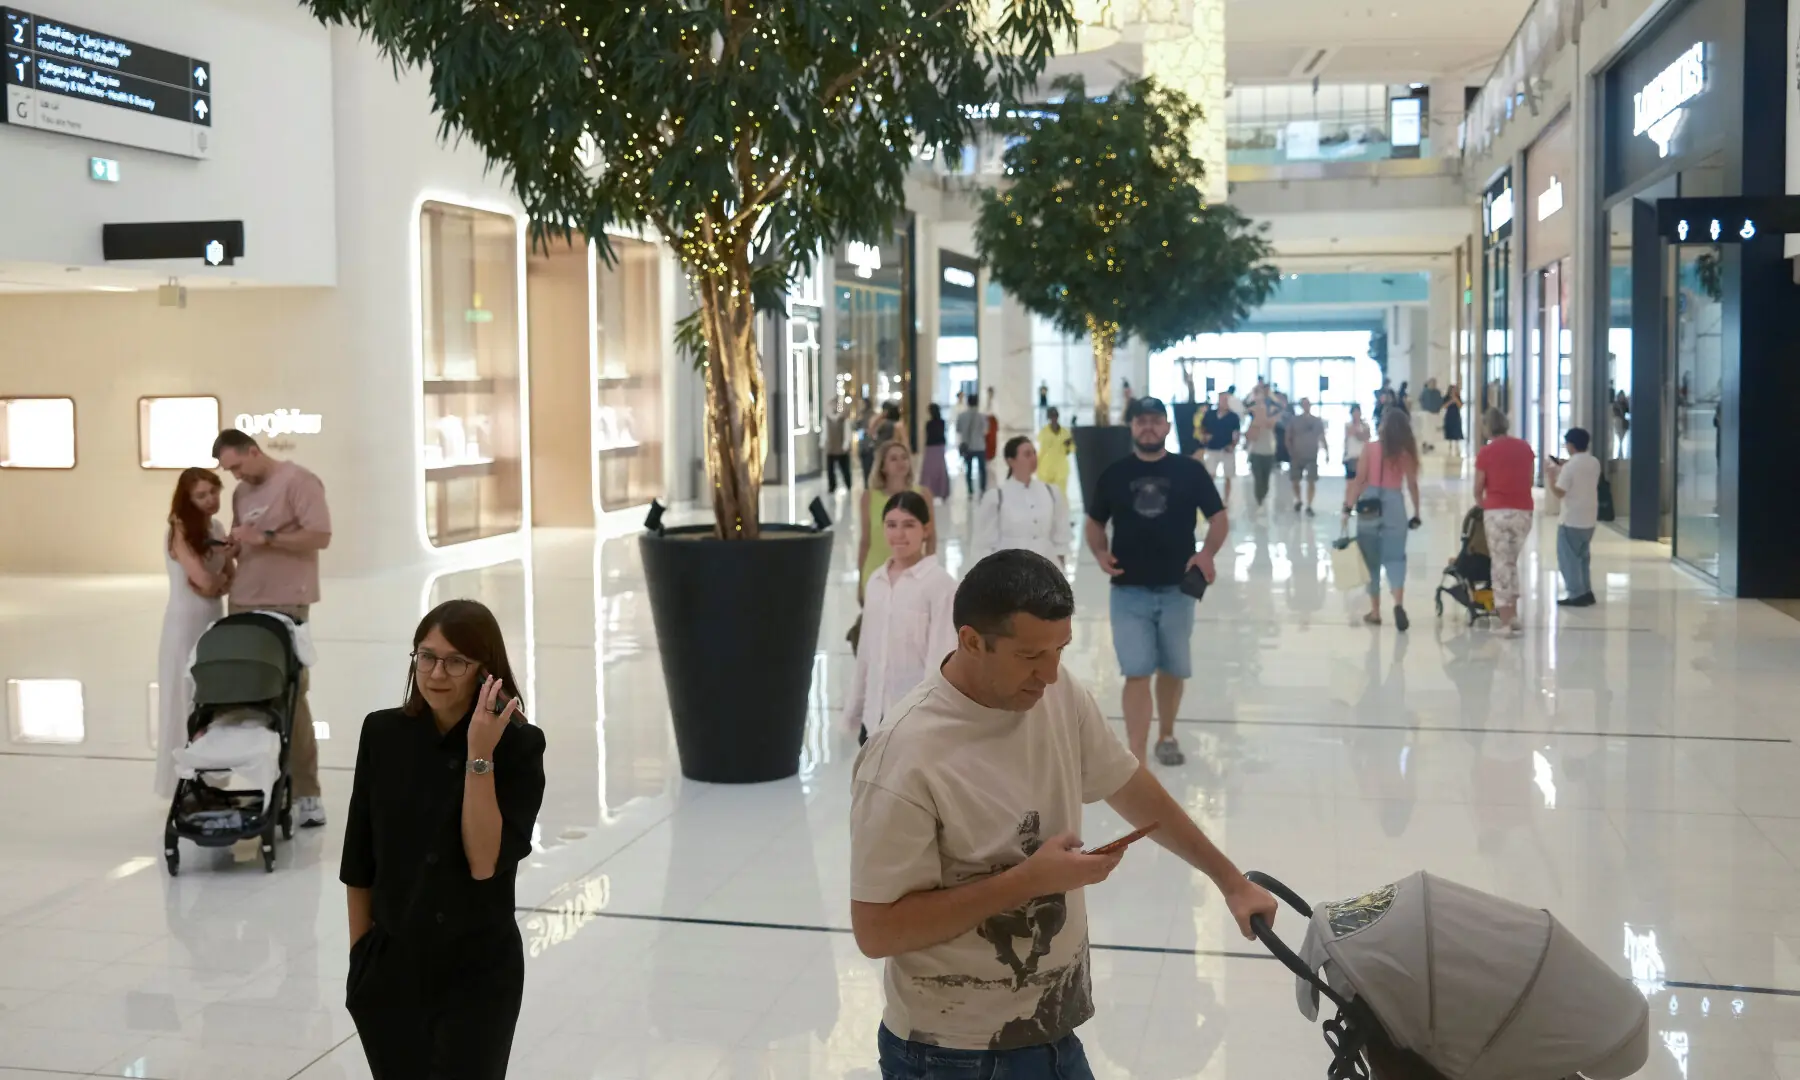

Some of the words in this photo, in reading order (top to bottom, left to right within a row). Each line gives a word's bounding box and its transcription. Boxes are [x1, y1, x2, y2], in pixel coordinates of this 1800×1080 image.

[13, 24, 24, 44] 2
[15, 62, 25, 82] 1
[17, 101, 28, 119] G
